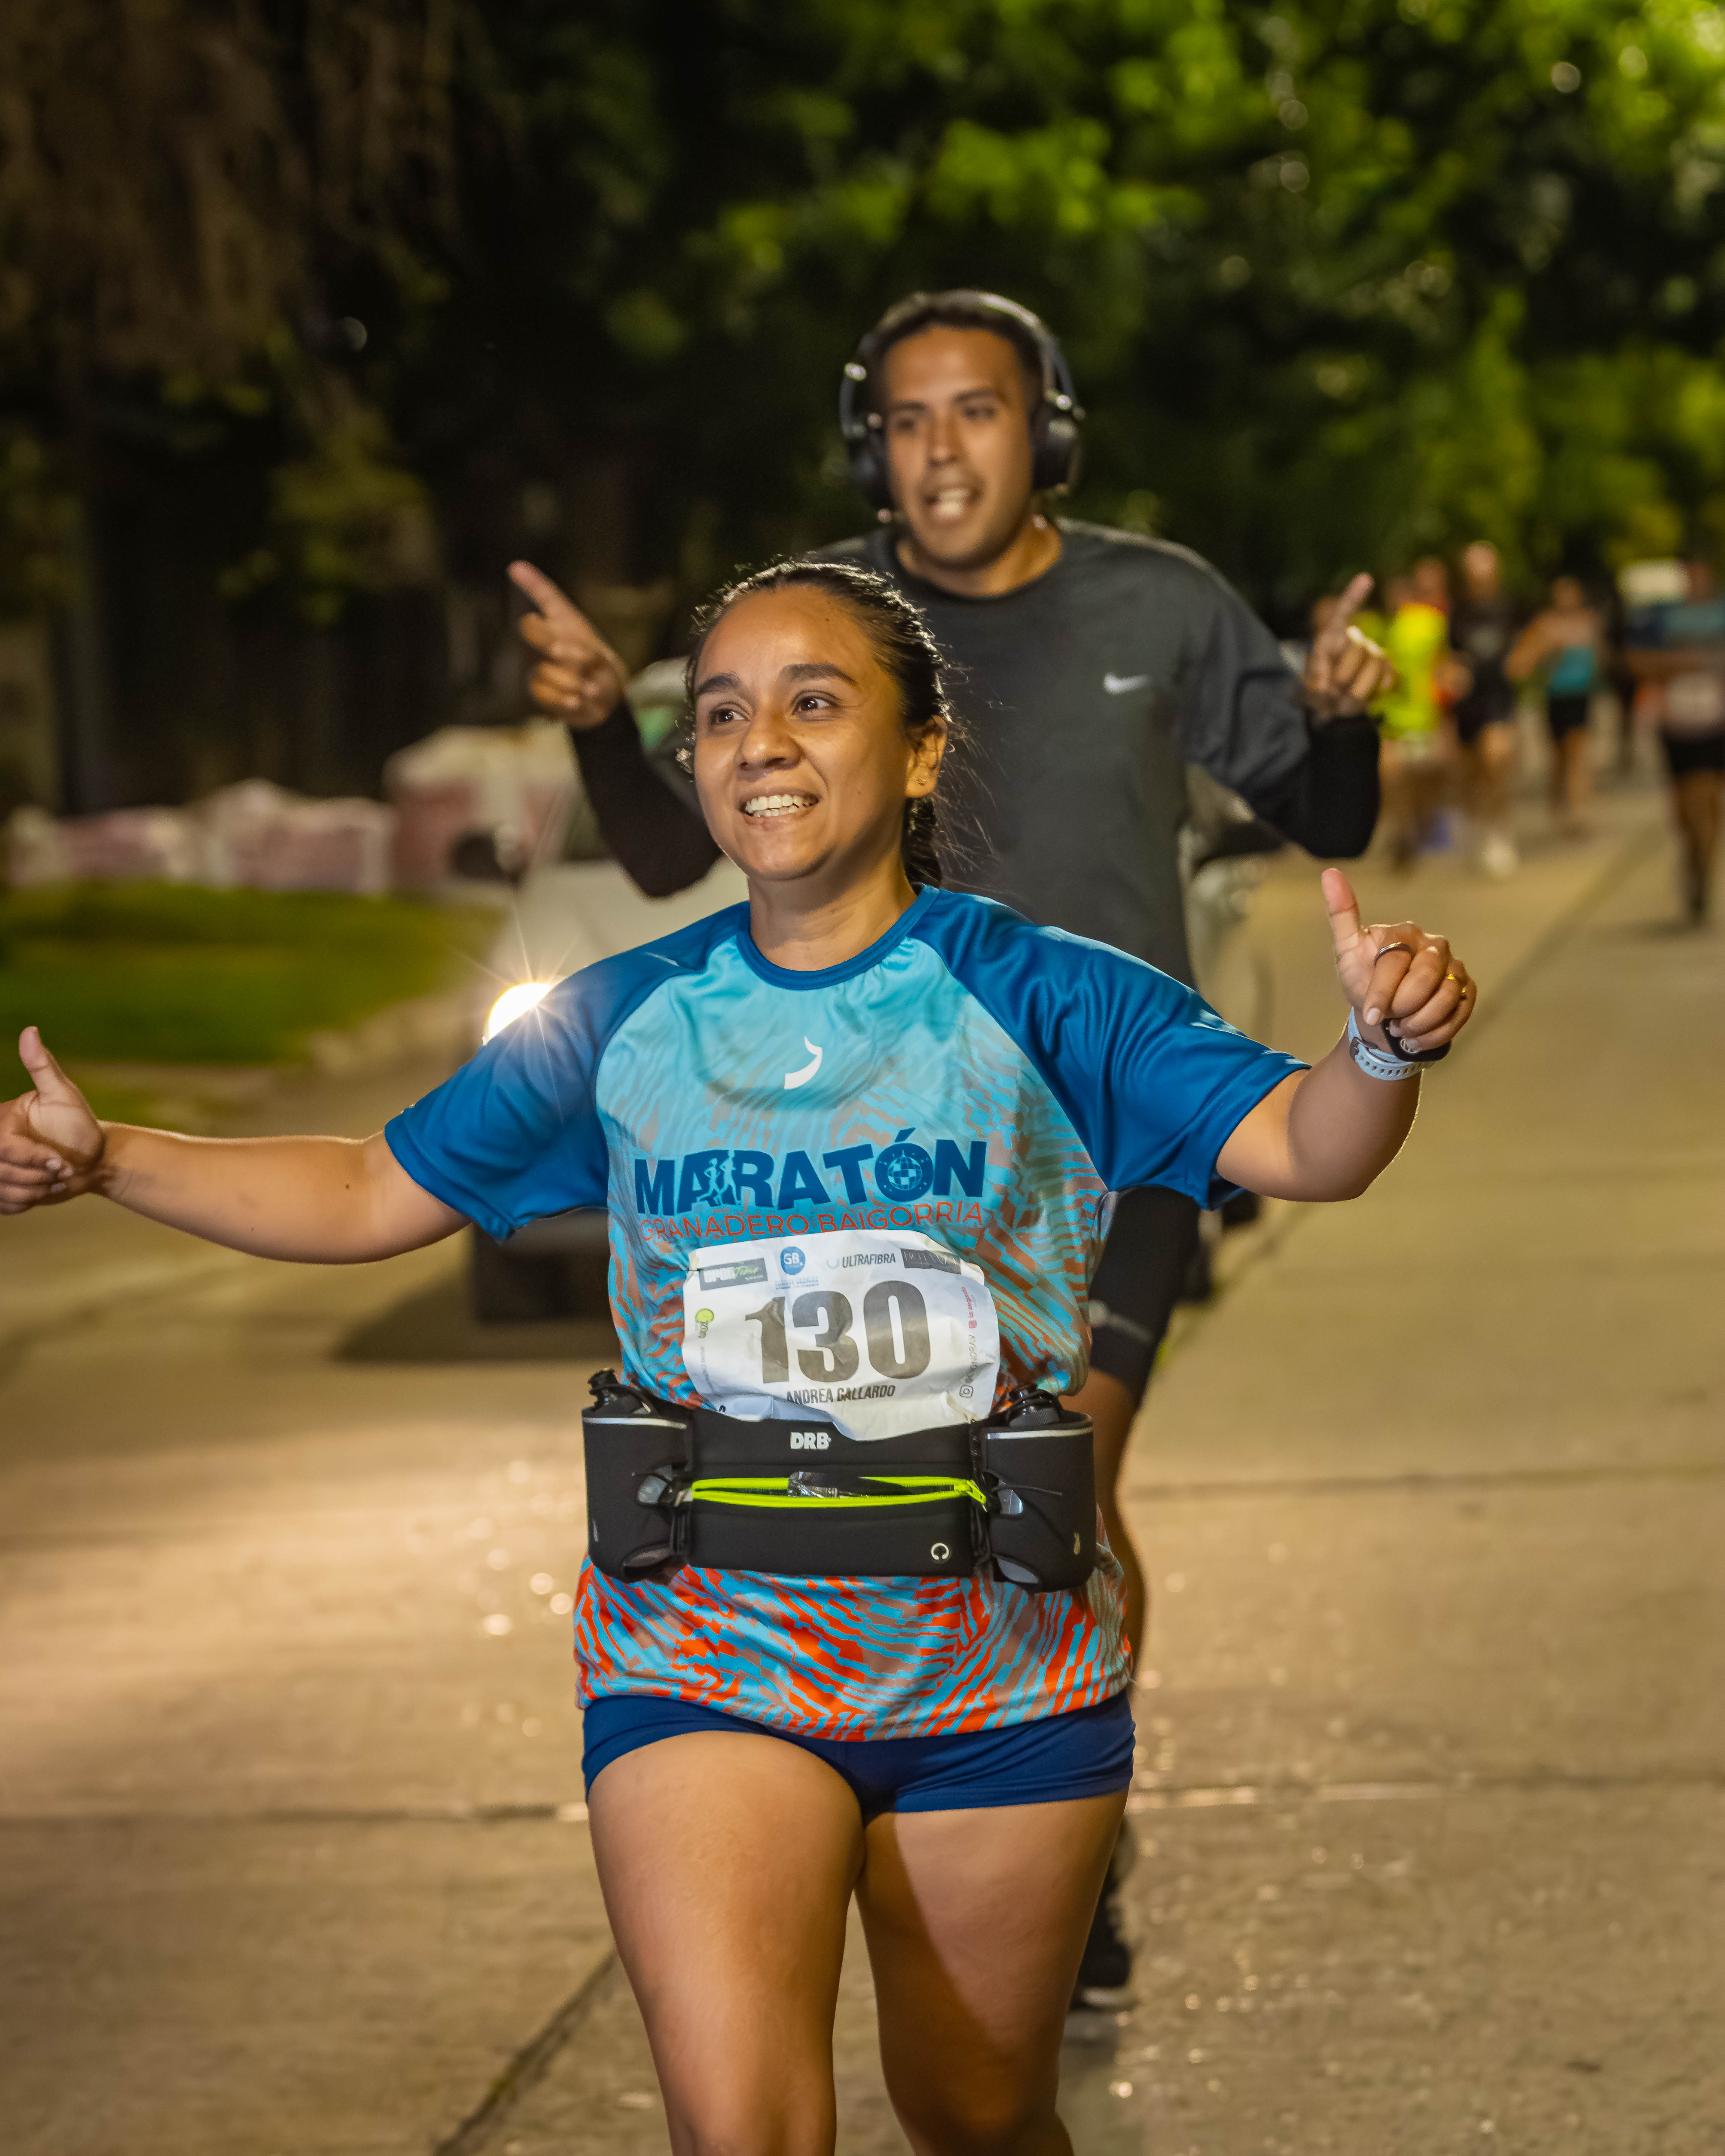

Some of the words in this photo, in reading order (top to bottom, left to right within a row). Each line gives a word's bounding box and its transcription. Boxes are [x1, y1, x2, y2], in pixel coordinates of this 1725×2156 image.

[635, 1128, 987, 1215] MARATÓN
[640, 1214, 809, 1241] GRANADERO
[817, 1201, 982, 1233] BAIGORRIA
[842, 1253, 896, 1268] ULTRAFIBRA
[745, 1280, 931, 1383] 130
[787, 1388, 834, 1404] ANDREA
[837, 1385, 895, 1401] GALLARDO
[790, 1432, 830, 1450] DRB
